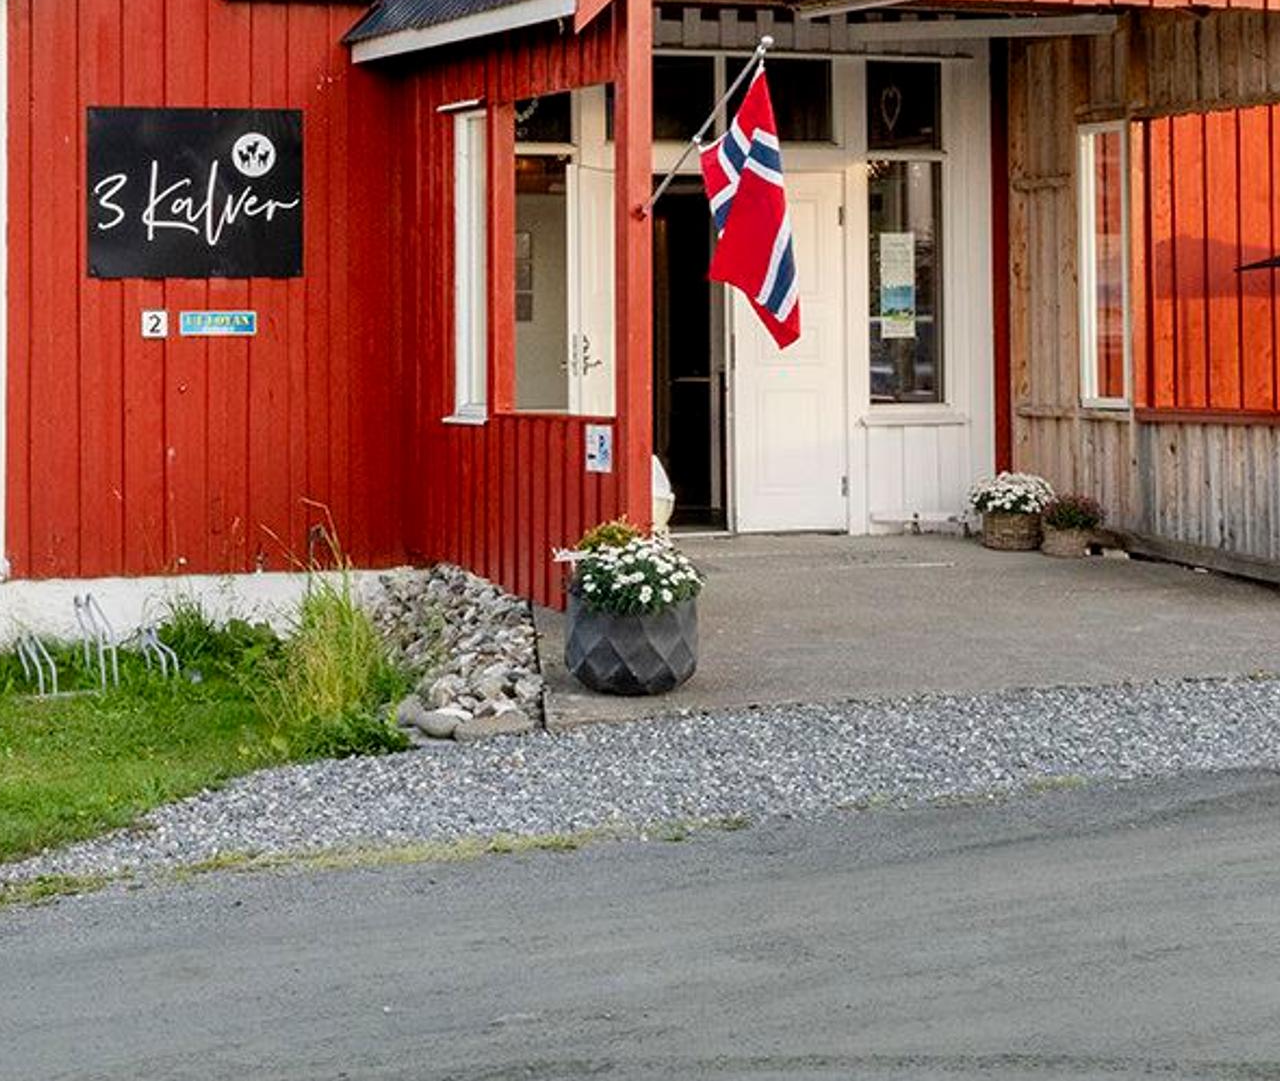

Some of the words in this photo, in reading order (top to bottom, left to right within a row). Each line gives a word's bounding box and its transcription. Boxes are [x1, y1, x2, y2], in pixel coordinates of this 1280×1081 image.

[93, 173, 128, 230] 3
[141, 159, 300, 246] Kalver
[148, 314, 162, 334] 2
